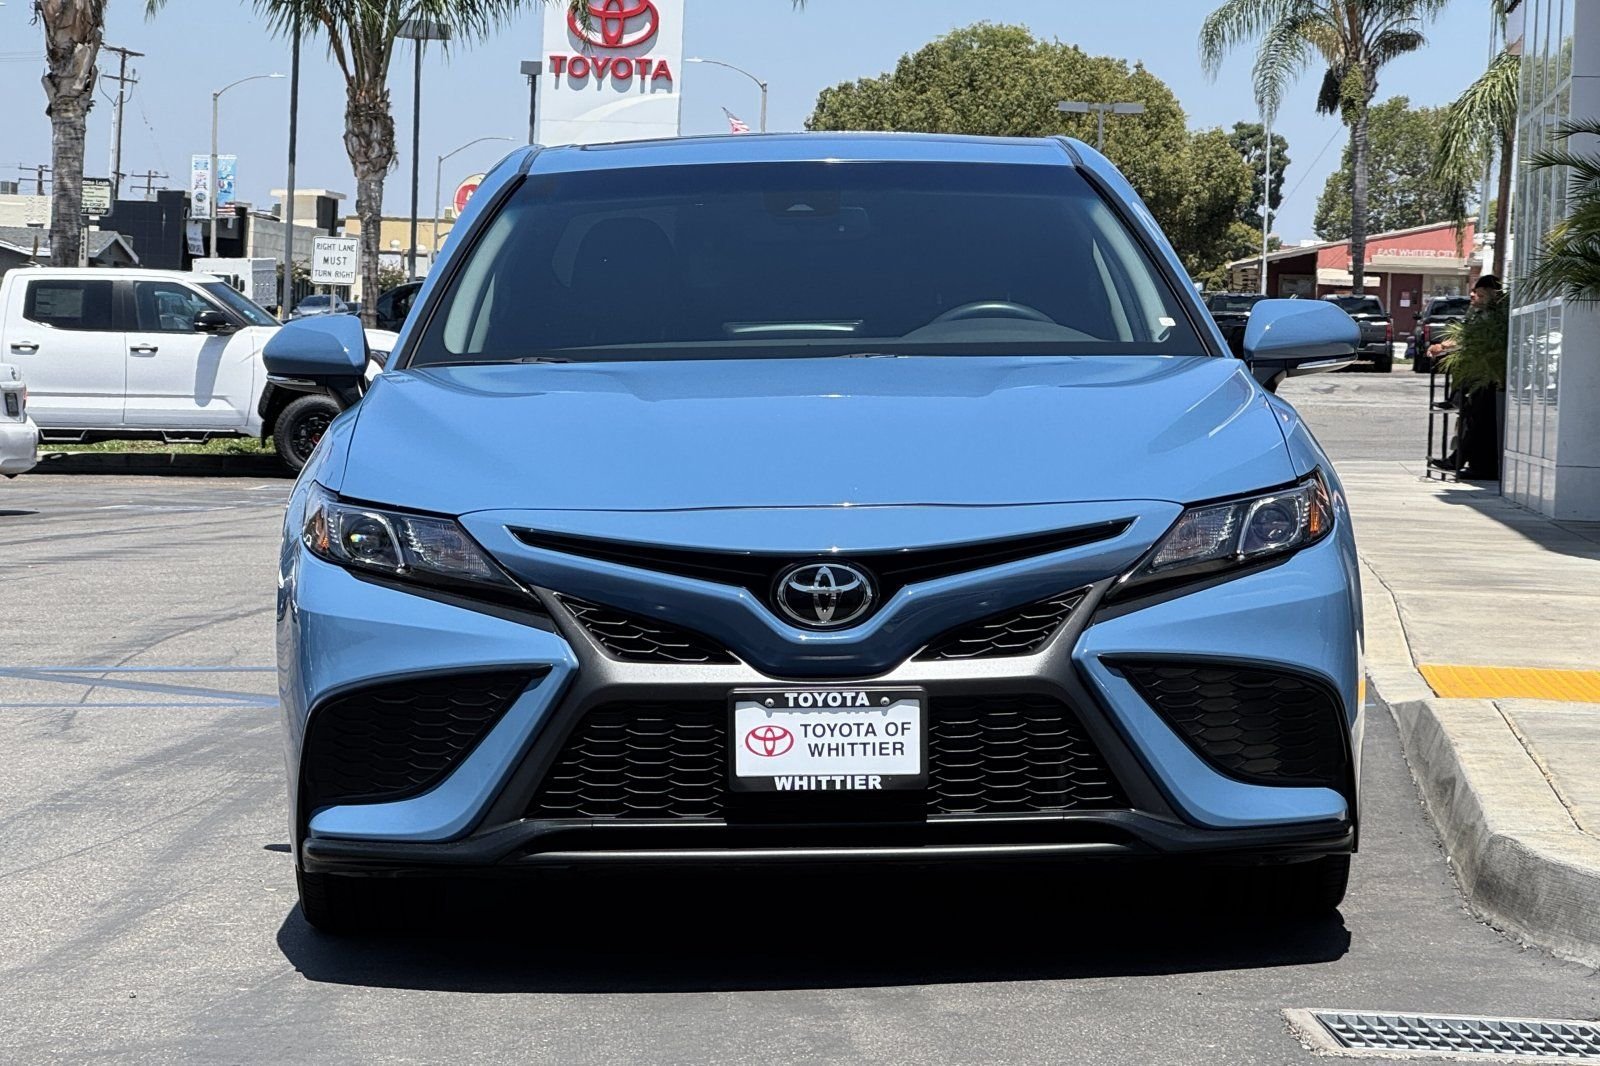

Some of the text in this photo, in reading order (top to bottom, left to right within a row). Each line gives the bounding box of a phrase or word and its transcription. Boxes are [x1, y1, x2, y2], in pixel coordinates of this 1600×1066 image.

[549, 55, 673, 81] TOYOTA
[316, 242, 355, 252] RIGHT LANE
[1377, 248, 1397, 256] EAST
[1399, 248, 1436, 257] WHITTIER
[323, 256, 347, 265] MUST
[314, 269, 354, 279] TURN RIGHT
[784, 692, 870, 707] TOYOTA
[800, 721, 912, 738] TOYOTA OF
[808, 741, 905, 757] WHITTIER
[774, 775, 882, 791] WHITTIER
